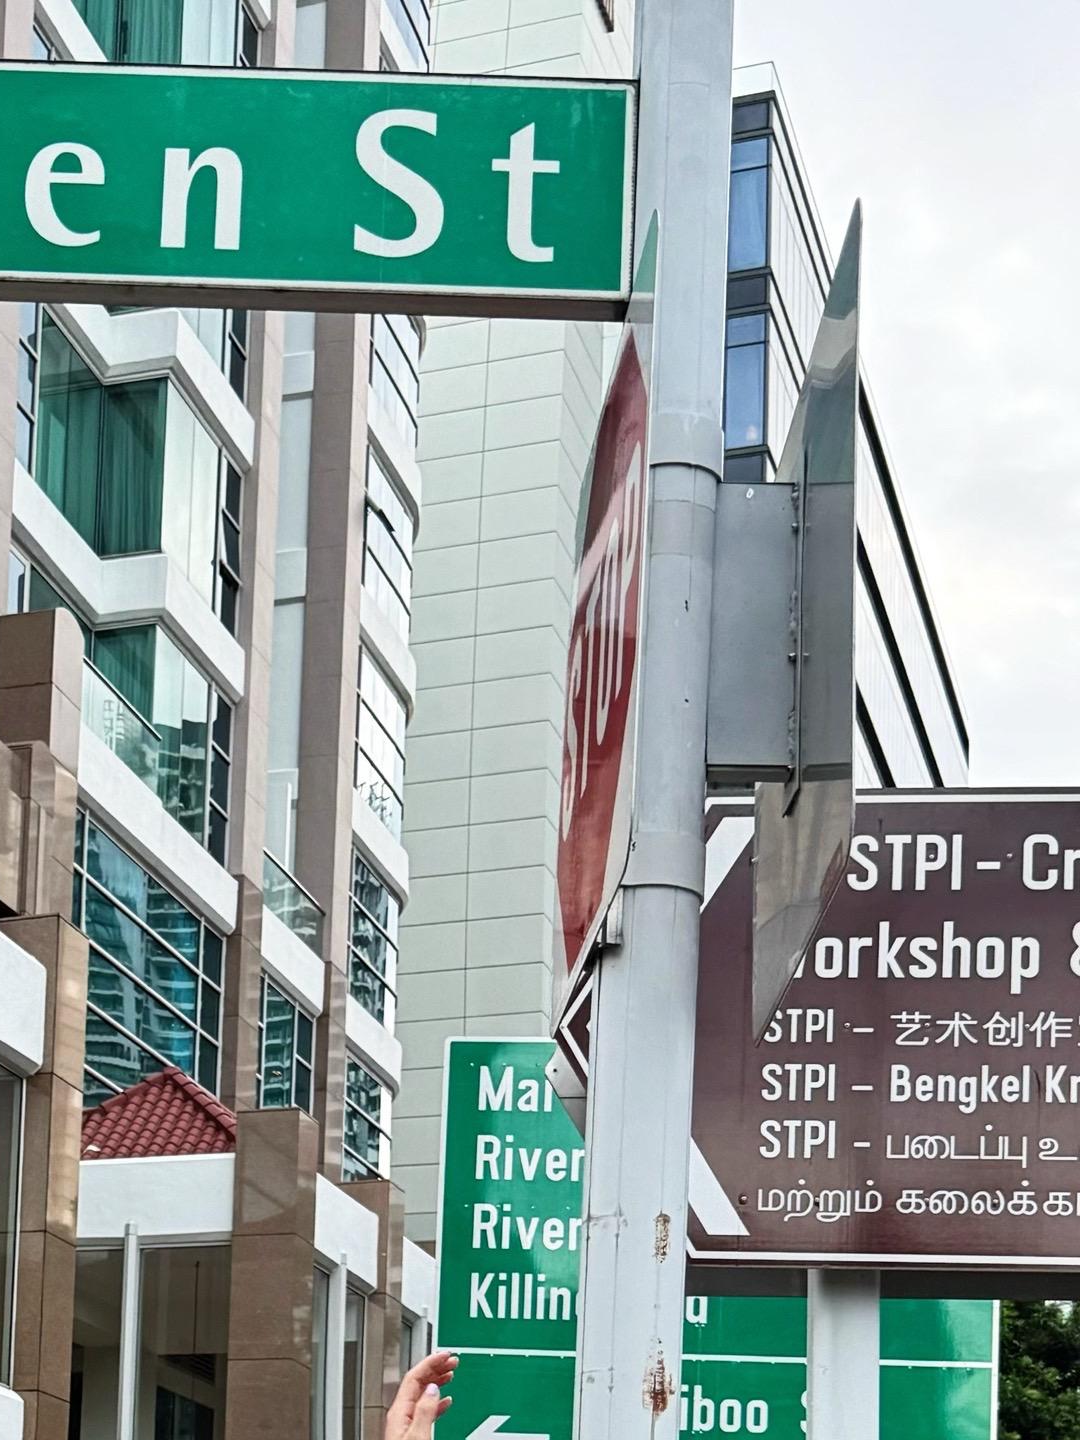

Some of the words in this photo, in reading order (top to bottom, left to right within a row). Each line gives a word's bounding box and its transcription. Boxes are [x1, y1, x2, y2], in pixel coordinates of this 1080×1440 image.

[353, 108, 560, 263] St
[562, 440, 641, 842] STOP
[848, 835, 962, 890] STPI
[792, 921, 1039, 994] orkshop
[764, 1009, 833, 1042] STPI
[890, 1011, 1080, 1047] 艺术创作
[762, 1064, 835, 1101] STPI
[890, 1065, 1030, 1113] Bengkel
[475, 1134, 585, 1182] River
[760, 1120, 835, 1158] STPI
[886, 1125, 1027, 1168] படைப்பு
[758, 1179, 882, 1222] மற்றும்
[896, 1180, 1080, 1216] கலைக்க
[472, 1203, 583, 1251] River
[469, 1272, 580, 1321] Killin
[680, 1383, 769, 1434] iboo
